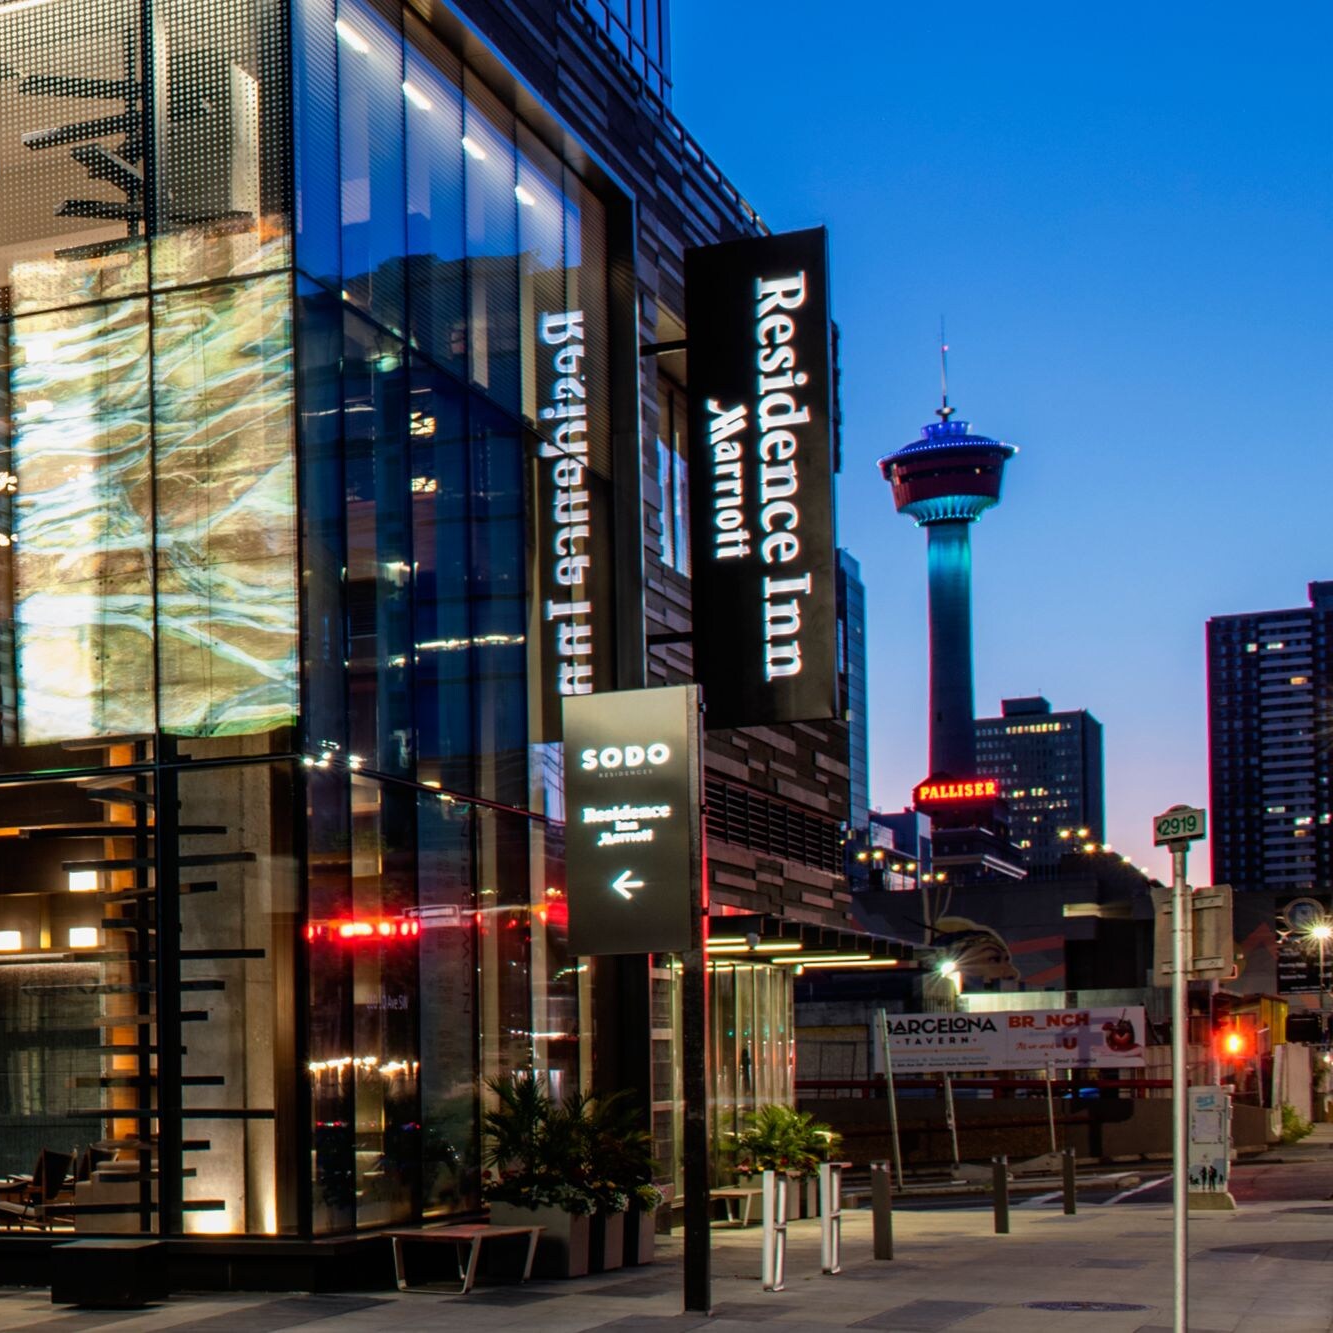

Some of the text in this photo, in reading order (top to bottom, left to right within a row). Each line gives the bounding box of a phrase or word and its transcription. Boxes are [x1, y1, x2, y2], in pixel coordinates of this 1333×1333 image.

[707, 398, 751, 560] Marriott
[755, 271, 811, 681] Residence Inn
[581, 743, 671, 771] SODO
[598, 768, 654, 779] RESIDENCES
[919, 781, 996, 800] PALLISER
[582, 804, 672, 824] Residence
[1162, 815, 1197, 836] 2919
[884, 1017, 997, 1035] BARCELONA
[1008, 1013, 1090, 1030] BR_NCH
[905, 1036, 969, 1045] TAVERN
